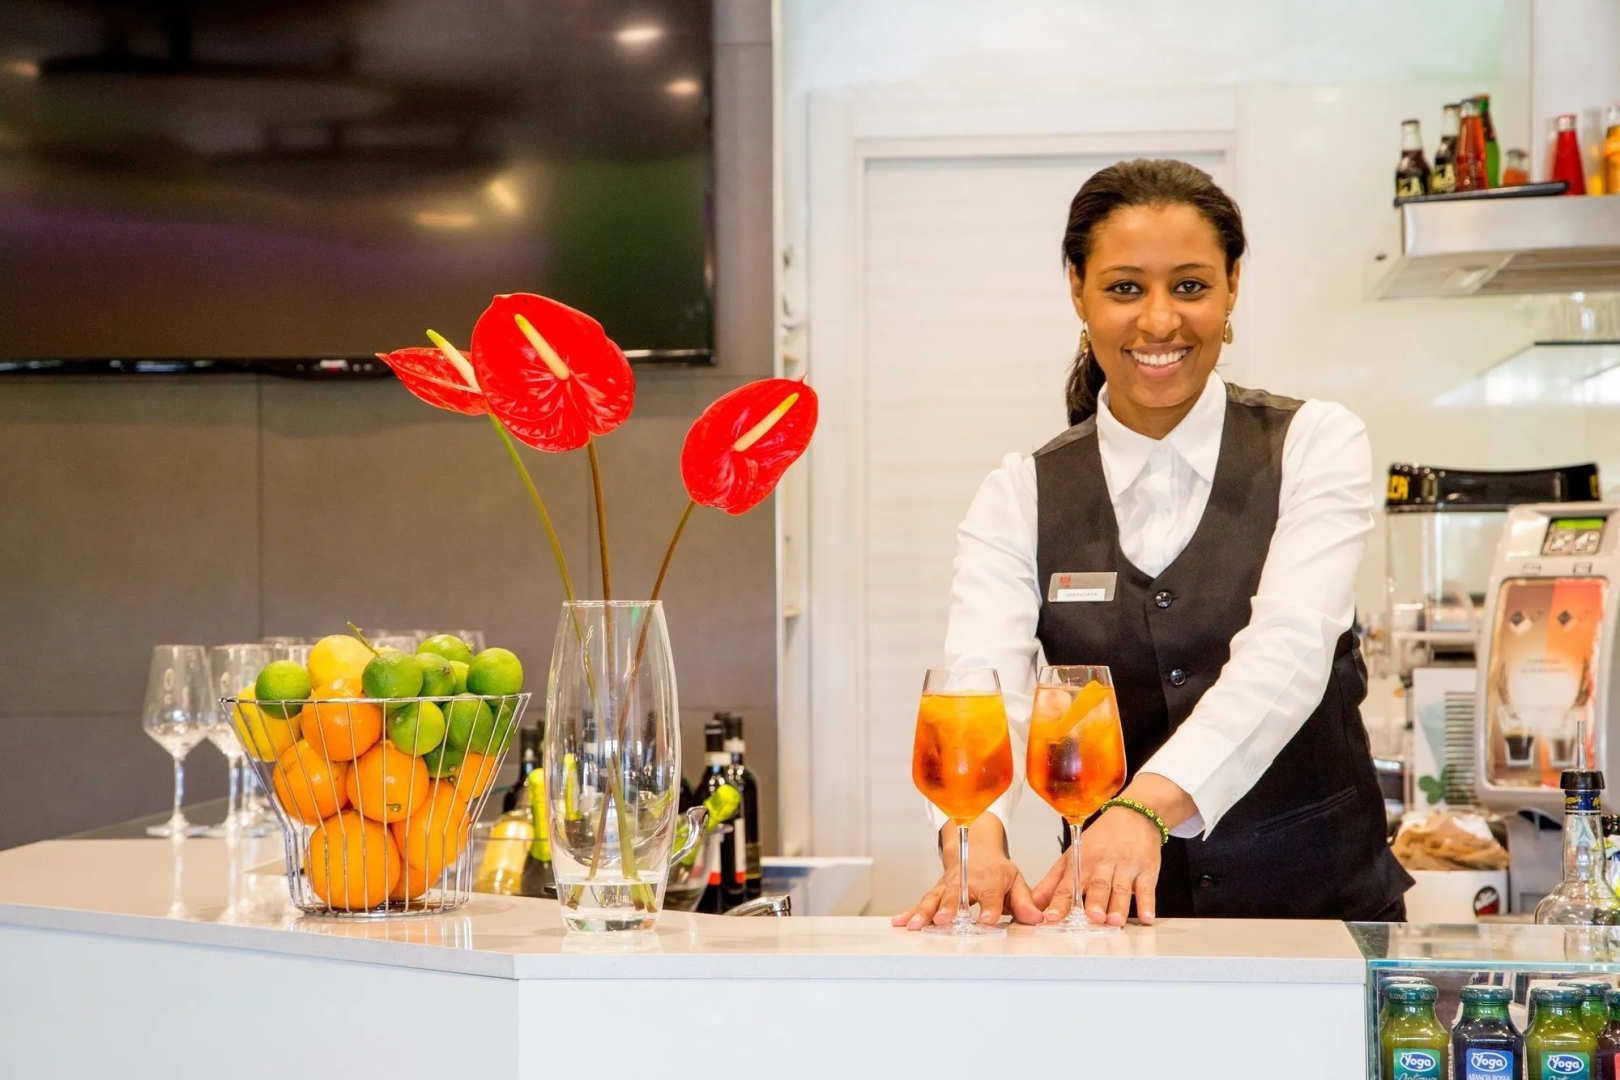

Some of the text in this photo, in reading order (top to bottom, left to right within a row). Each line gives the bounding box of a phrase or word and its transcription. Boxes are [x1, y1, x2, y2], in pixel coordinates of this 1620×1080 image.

[1402, 1053, 1432, 1069] Yoga
[1472, 1053, 1503, 1069] Yoga
[1549, 1055, 1580, 1071] Yoga
